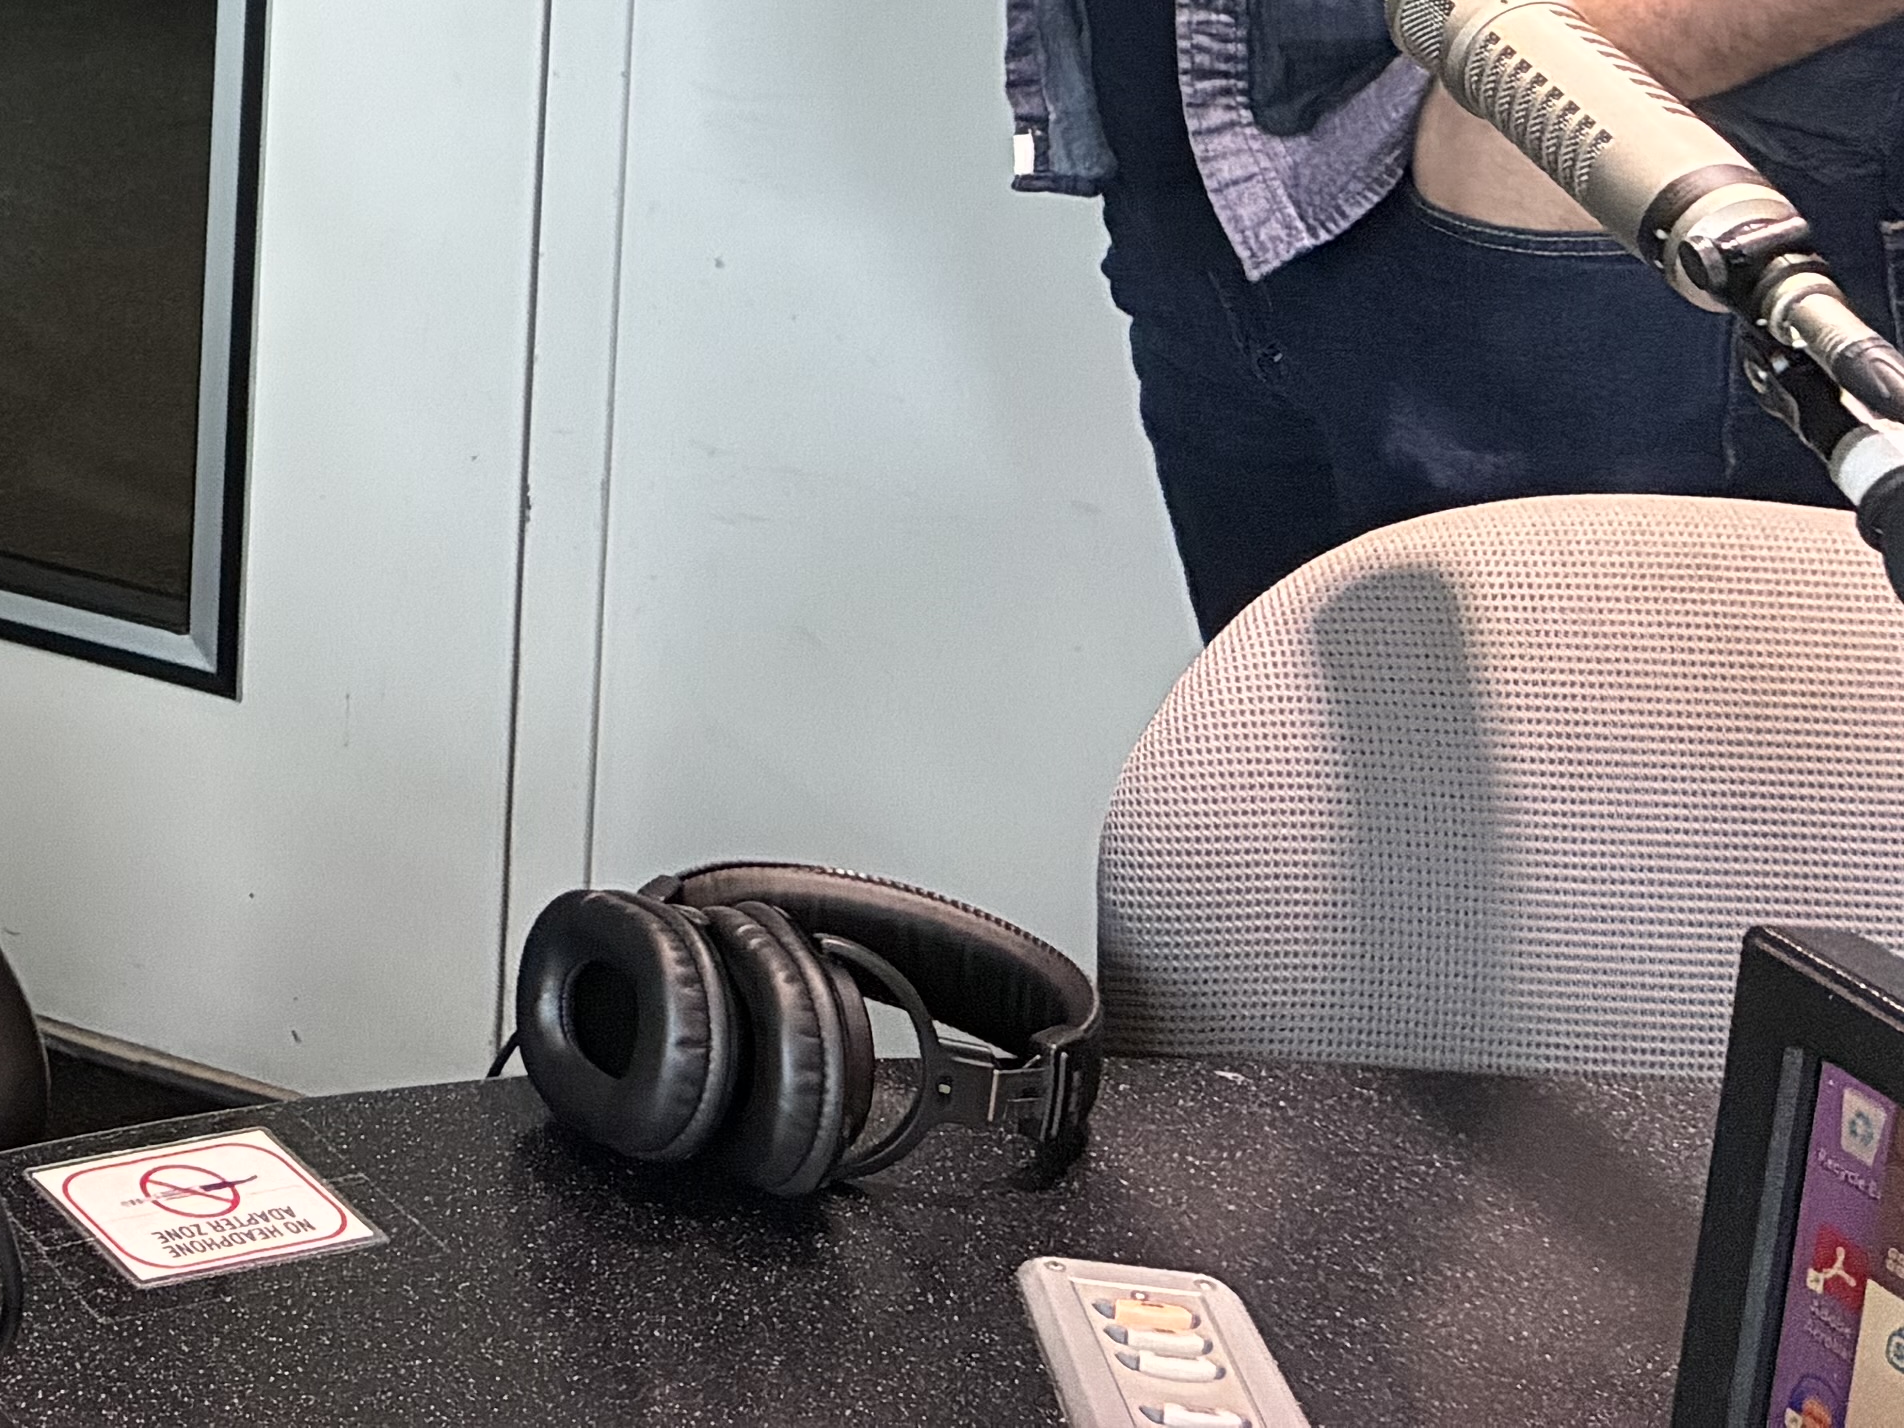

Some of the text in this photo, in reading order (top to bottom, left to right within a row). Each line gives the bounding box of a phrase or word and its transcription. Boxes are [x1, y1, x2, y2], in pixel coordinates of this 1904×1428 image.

[150, 1205, 297, 1245] ADAPTER ZONE
[161, 1217, 317, 1259] NO HEADPHONE
